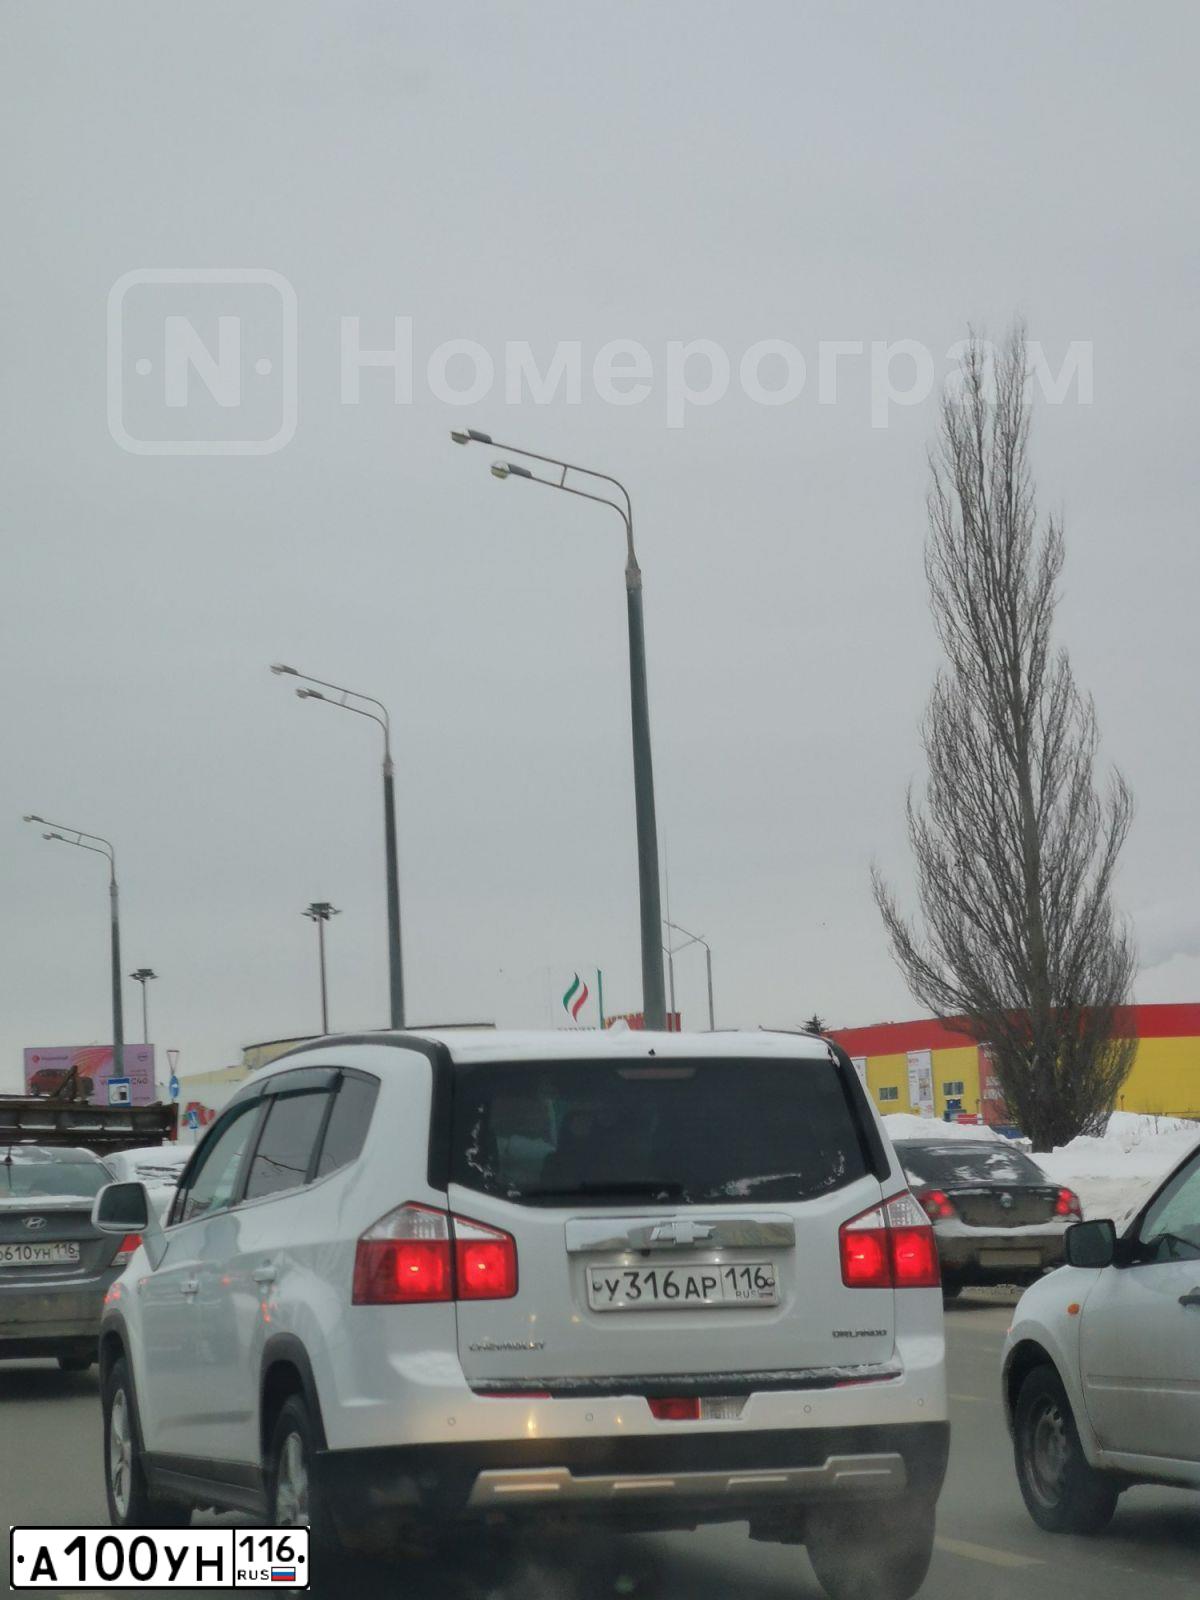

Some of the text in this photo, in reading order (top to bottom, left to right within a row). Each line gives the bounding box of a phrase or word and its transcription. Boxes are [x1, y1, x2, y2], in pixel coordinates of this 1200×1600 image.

[54, 1242, 76, 1256] 116
[605, 1266, 766, 1301] У316АР 116
